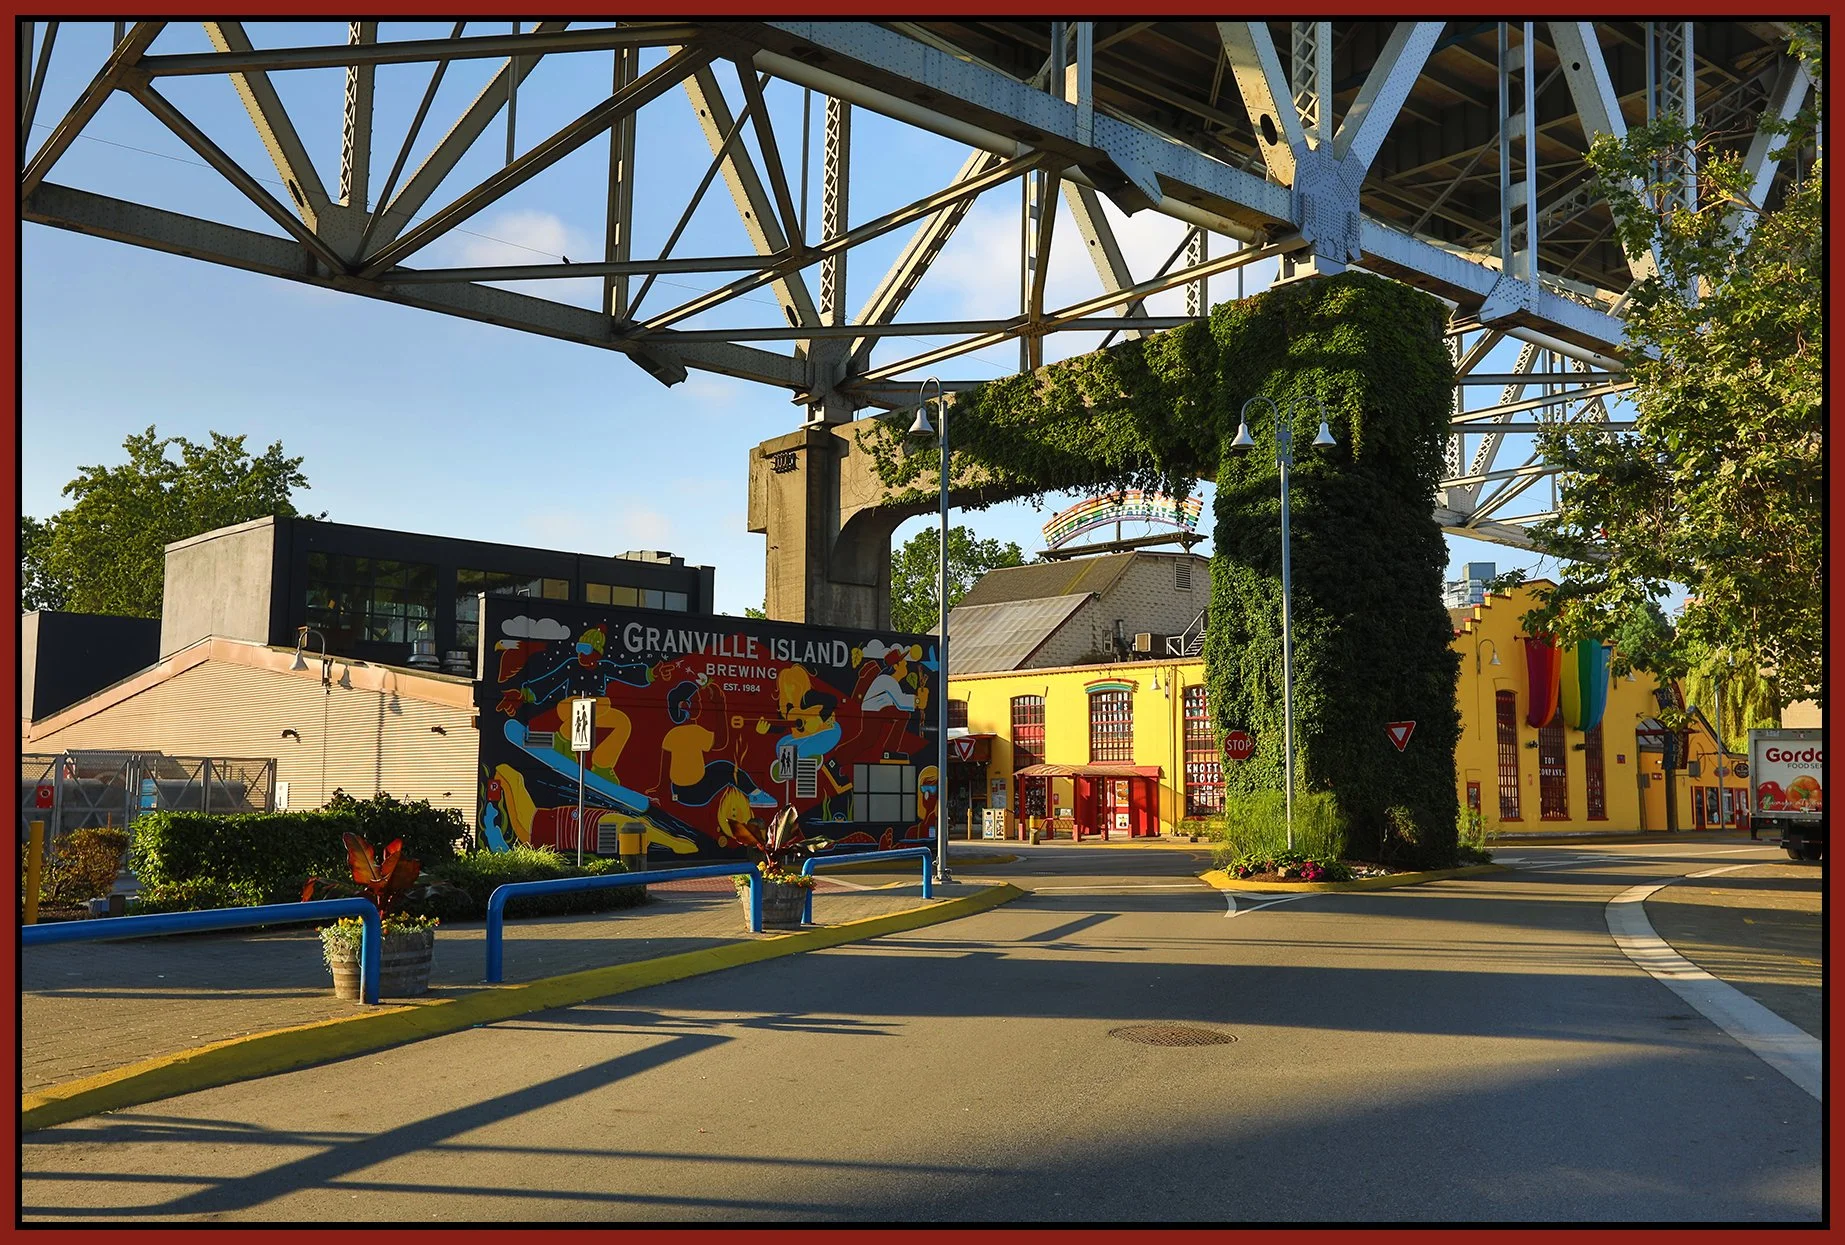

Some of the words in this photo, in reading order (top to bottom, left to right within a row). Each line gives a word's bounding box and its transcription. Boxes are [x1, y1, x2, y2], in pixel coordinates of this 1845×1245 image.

[624, 622, 759, 660] GRANVILLE
[770, 638, 849, 668] ISLAND
[705, 663, 777, 680] BREWING
[723, 683, 741, 692] EST.
[742, 684, 761, 693] 1984
[1226, 739, 1251, 750] STOP
[1193, 773, 1218, 783] TOYS
